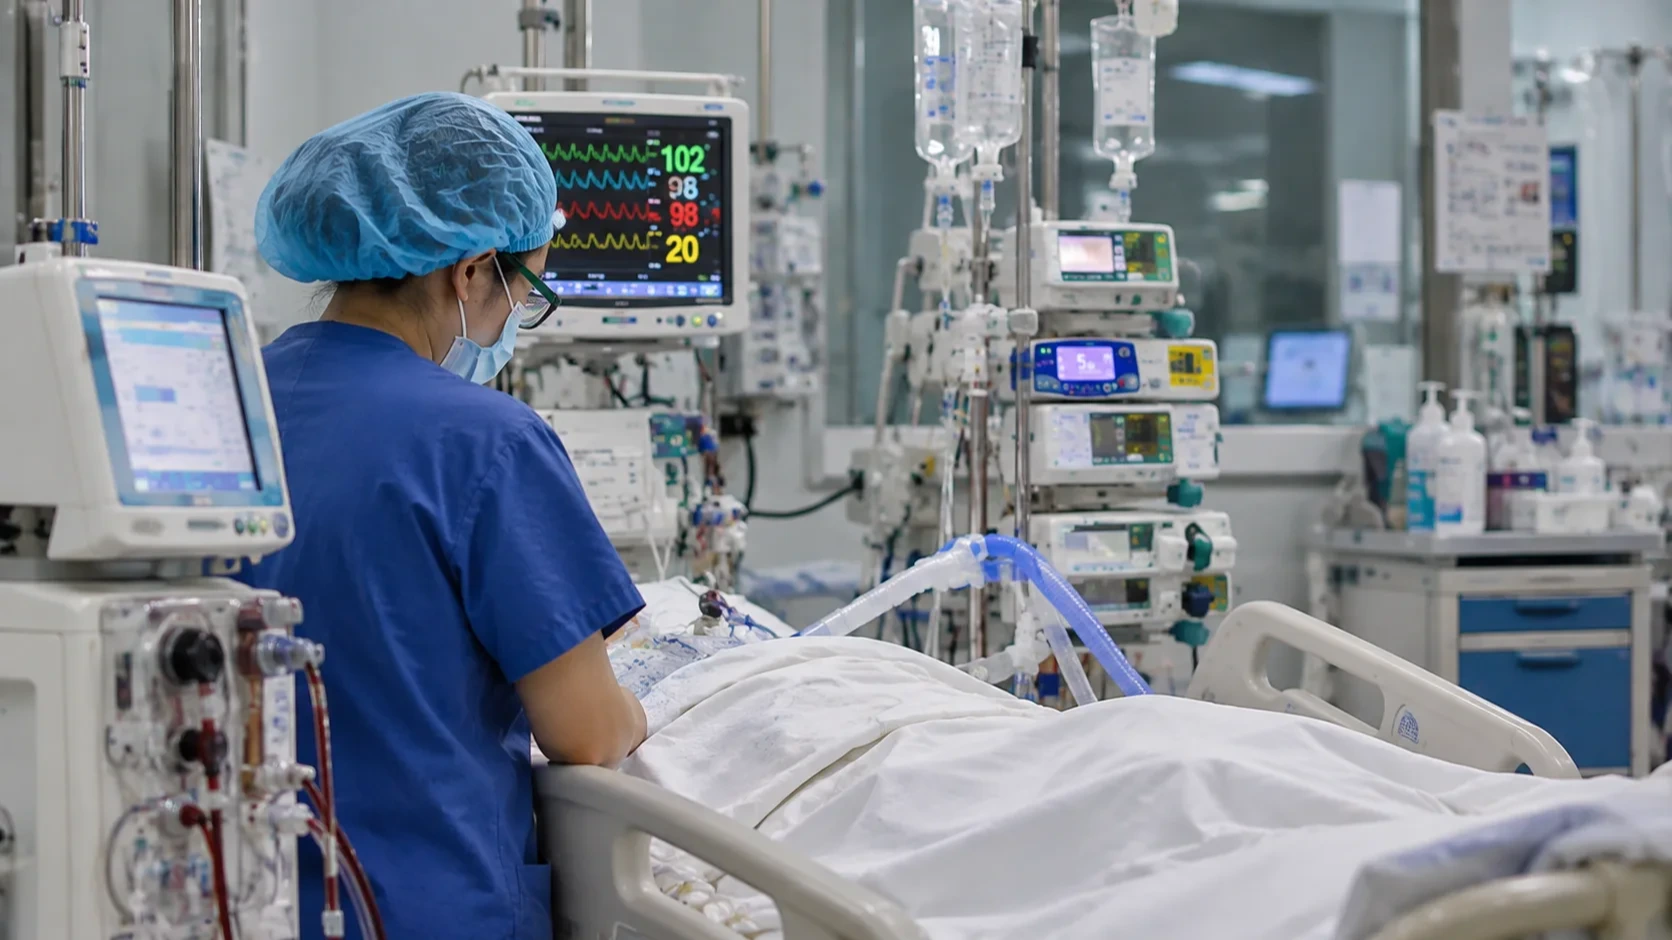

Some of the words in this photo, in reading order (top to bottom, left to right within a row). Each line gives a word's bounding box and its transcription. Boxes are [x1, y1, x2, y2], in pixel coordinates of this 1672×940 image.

[660, 144, 706, 174] 102
[668, 175, 699, 201] 98
[669, 202, 699, 228] 98
[665, 234, 700, 264] 20
[1076, 353, 1087, 370] 5
